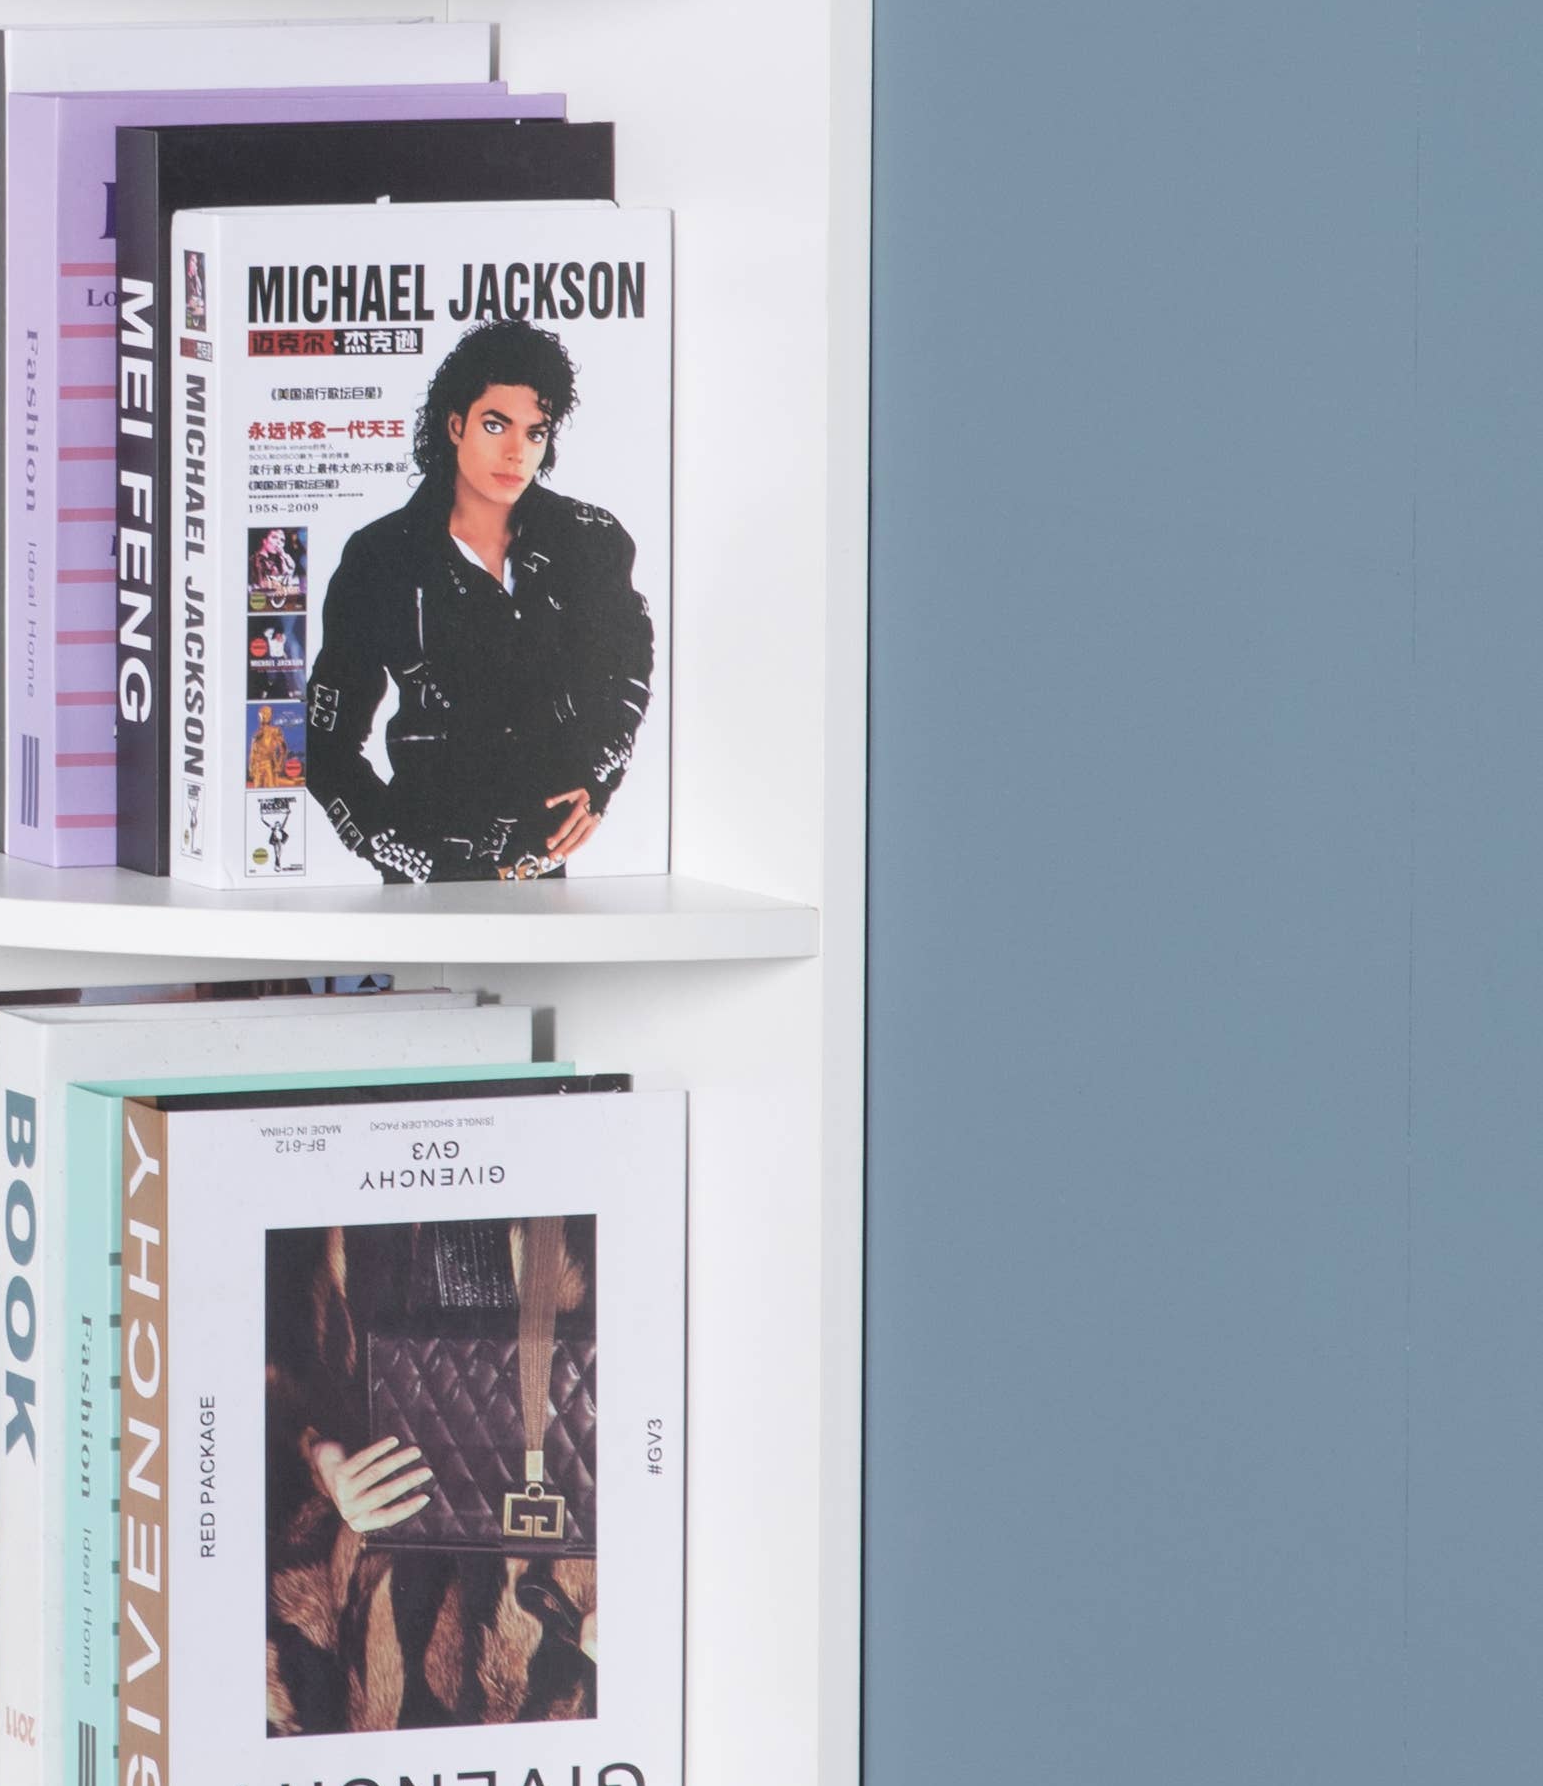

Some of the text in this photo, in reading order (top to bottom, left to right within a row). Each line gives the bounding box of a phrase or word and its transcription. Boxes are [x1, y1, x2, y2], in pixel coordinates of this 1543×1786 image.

[248, 260, 646, 324] MICHAEL JACKSON
[25, 328, 38, 512] Fashion
[184, 373, 206, 562] MICHAEL
[248, 419, 405, 440] 永远怀念一代天王
[118, 277, 154, 724] MEI FENG
[26, 541, 37, 699] Ideal Home
[183, 575, 205, 777] JACKSON
[260, 1124, 342, 1137] MADE IN CHINA
[275, 1138, 326, 1154] BF-612
[359, 1165, 506, 1191] GIVENCHY
[402, 1118, 455, 1130] SHOULDER
[411, 1140, 461, 1160] GV3
[5, 1088, 37, 1466] BOOK
[80, 1314, 93, 1499] Fashion
[647, 1418, 663, 1475] #GV3
[200, 1394, 217, 1559] RED PACKAGE
[82, 1526, 93, 1687] Ideal Home
[5, 1704, 36, 1748] 2011
